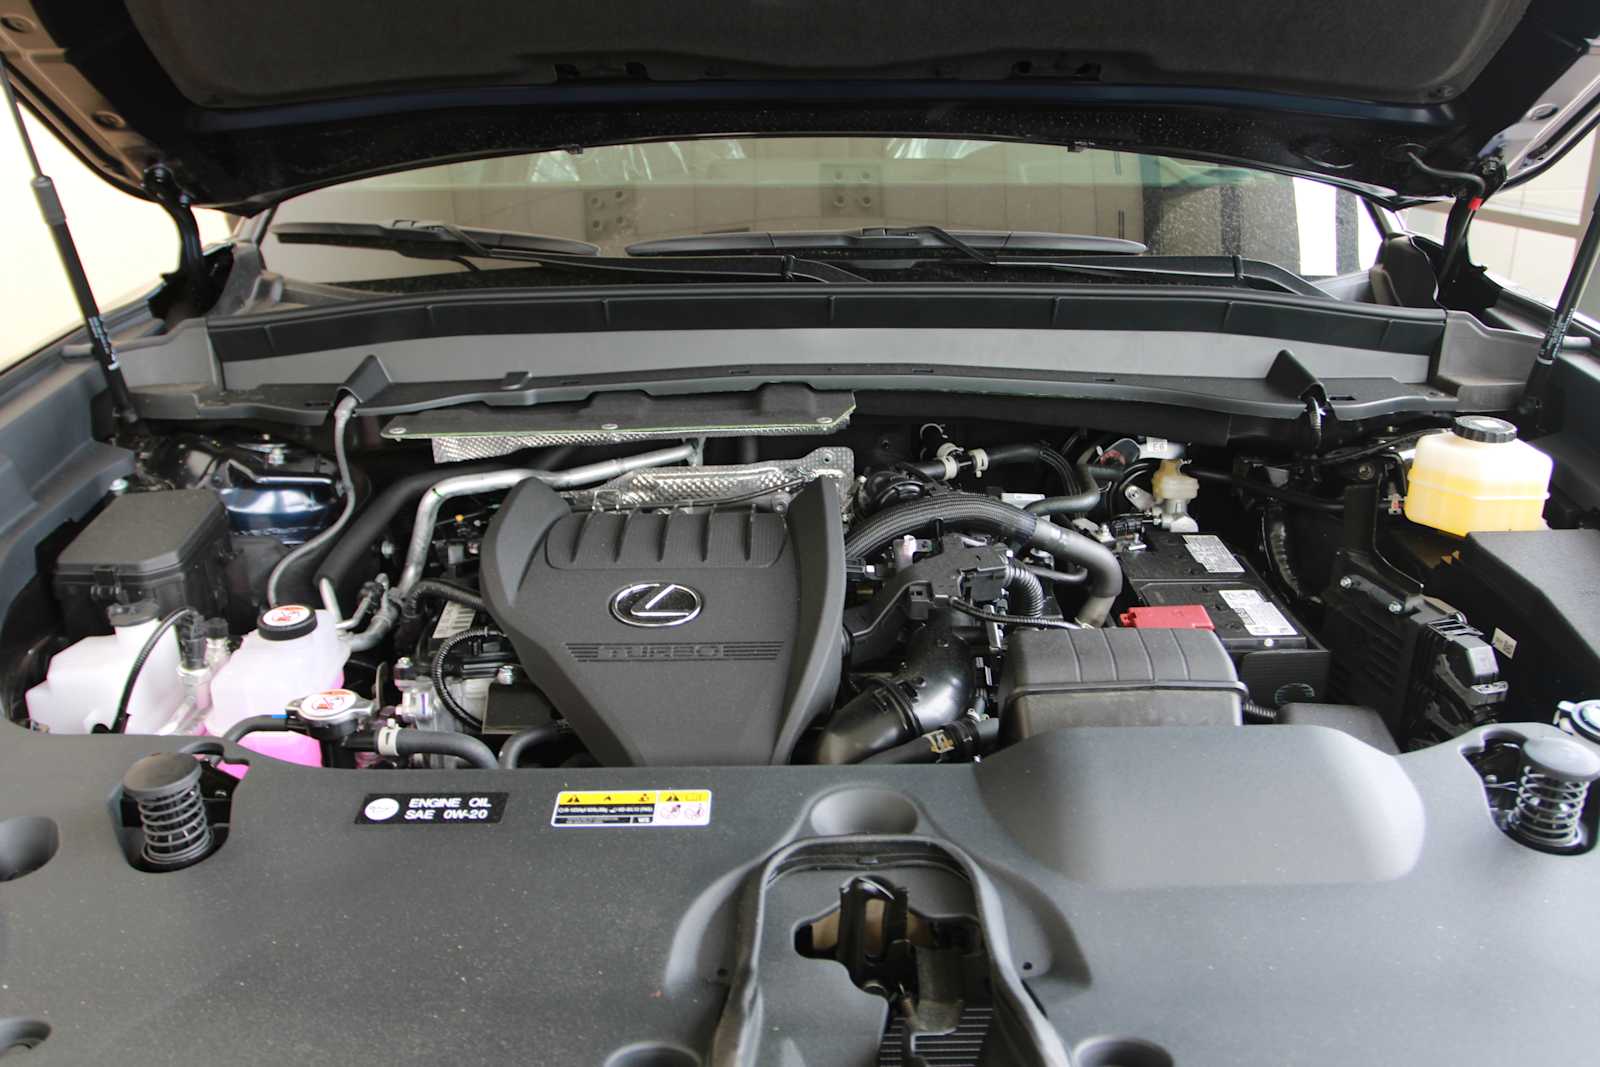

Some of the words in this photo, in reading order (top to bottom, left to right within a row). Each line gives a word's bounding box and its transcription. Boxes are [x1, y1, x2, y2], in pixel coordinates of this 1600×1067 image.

[603, 645, 721, 659] TURBO
[408, 797, 462, 808] ENGINE
[468, 797, 492, 808] OIL
[404, 809, 436, 820] SAE
[443, 809, 489, 820] 0W-20
